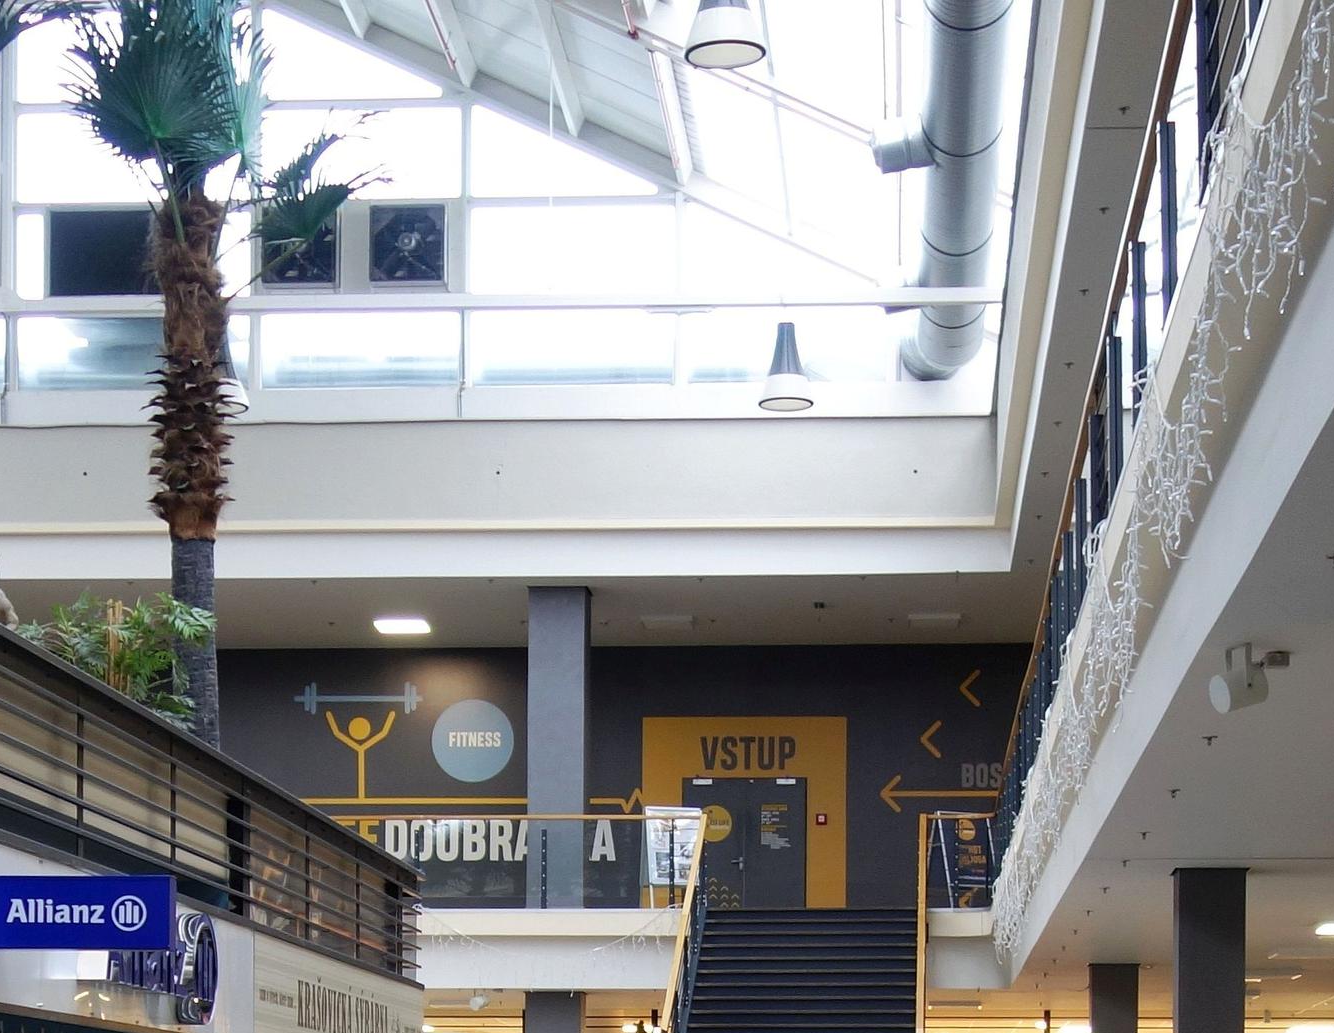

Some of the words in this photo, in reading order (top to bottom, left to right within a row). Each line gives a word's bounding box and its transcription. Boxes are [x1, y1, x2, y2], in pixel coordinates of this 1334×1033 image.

[448, 731, 502, 748] FITNESS
[699, 735, 797, 772] VSTUP
[6, 897, 106, 925] Allianz
